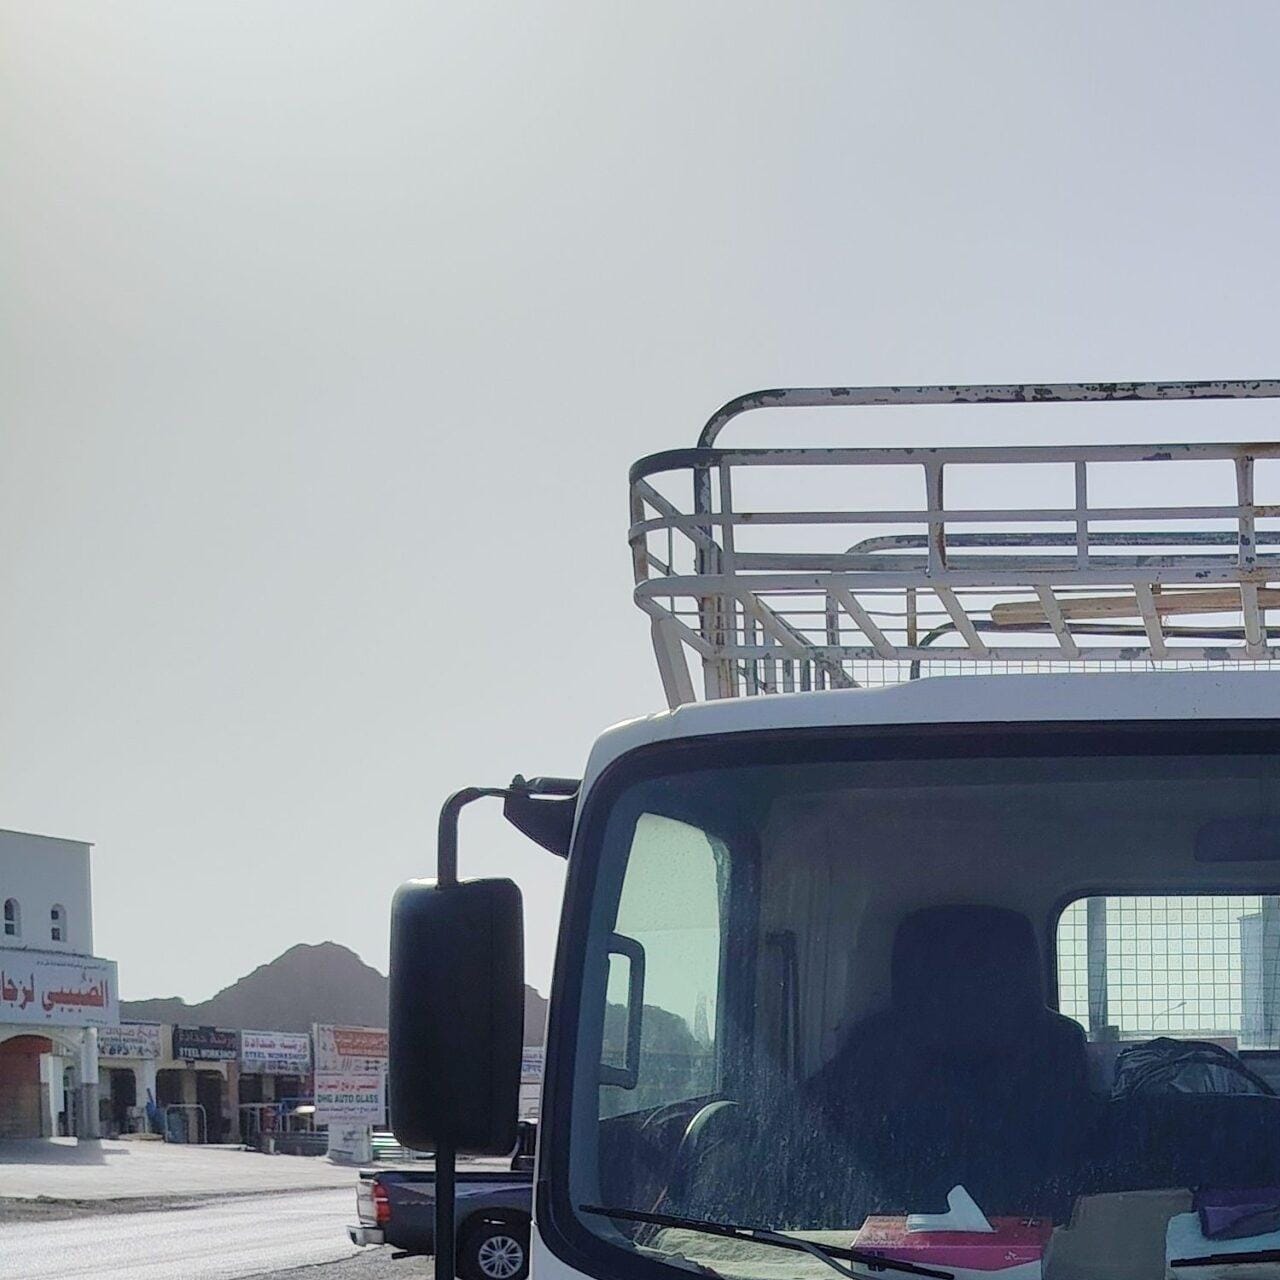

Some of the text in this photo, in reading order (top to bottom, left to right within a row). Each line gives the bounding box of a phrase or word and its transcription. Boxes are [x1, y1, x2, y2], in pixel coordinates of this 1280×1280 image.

[0, 971, 35, 1010] لزجا
[334, 1094, 354, 1103] AUTO
[355, 1094, 378, 1104] GLASS
